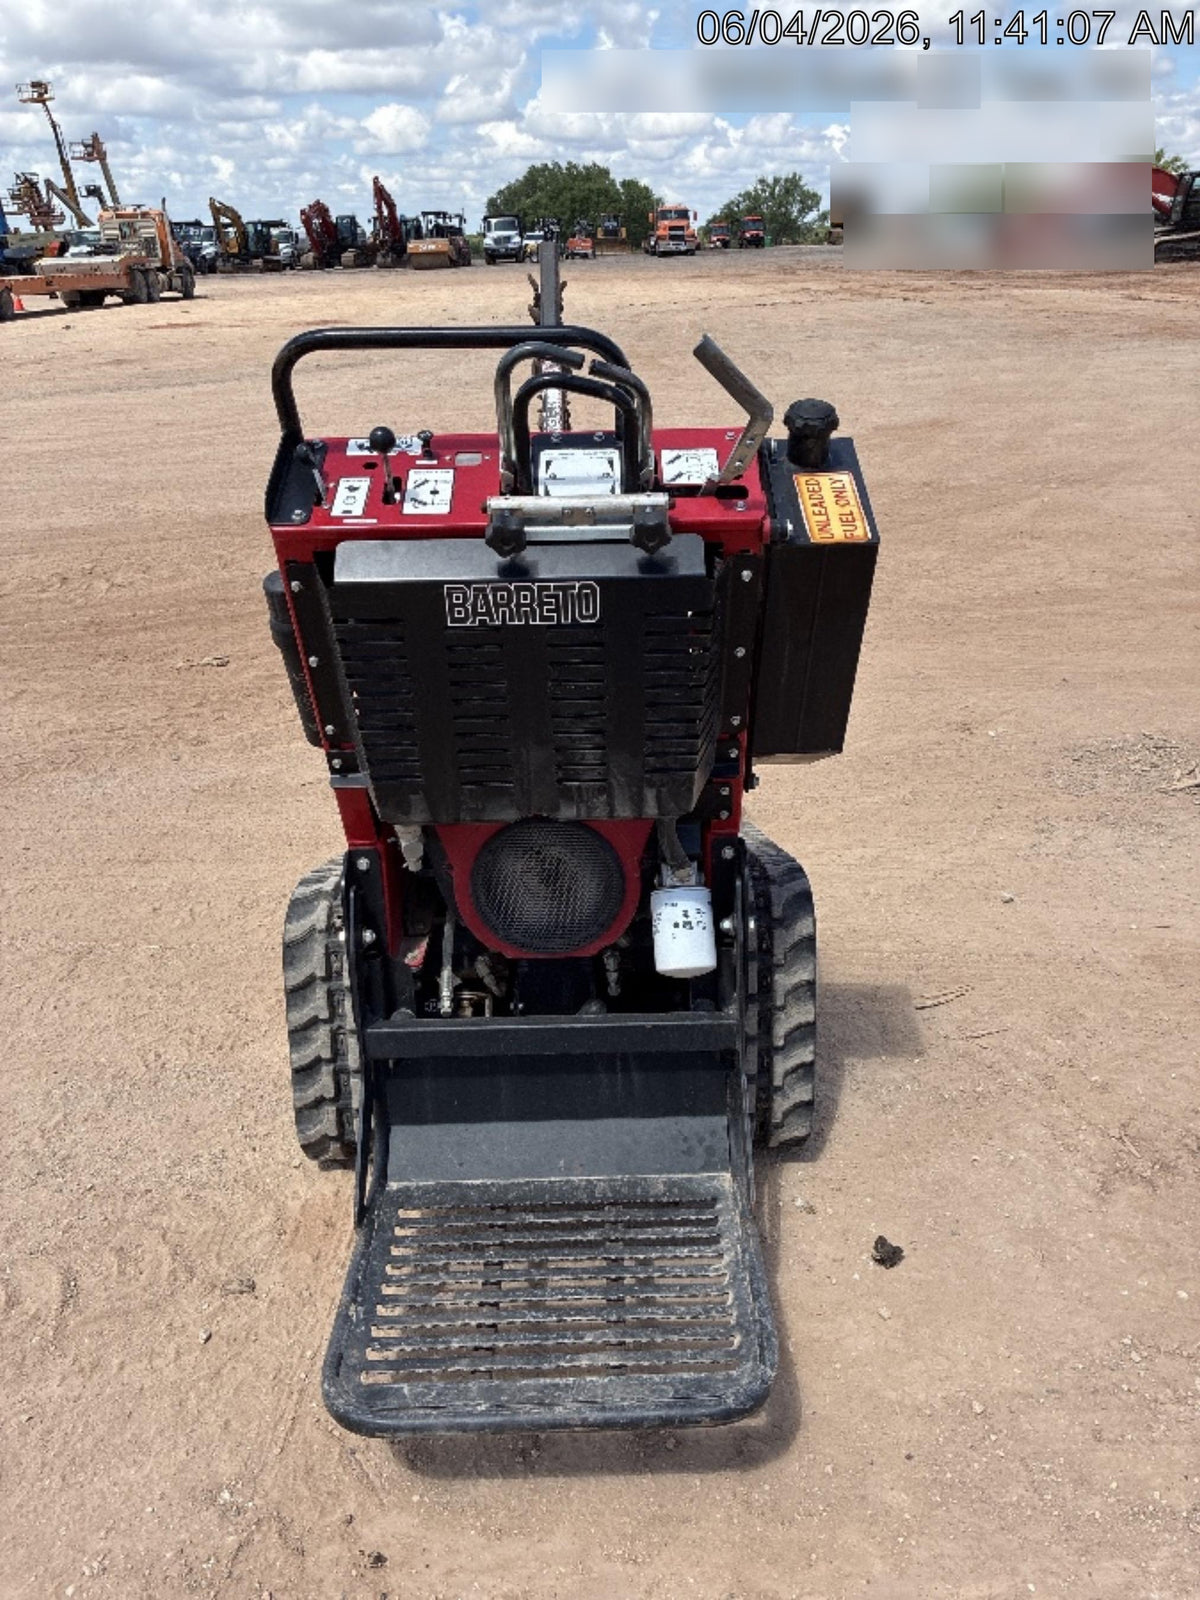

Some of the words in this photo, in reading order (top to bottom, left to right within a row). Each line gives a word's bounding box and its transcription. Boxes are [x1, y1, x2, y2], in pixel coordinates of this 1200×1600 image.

[805, 478, 834, 539] UNLEADED
[828, 477, 851, 507] ONLY
[839, 510, 860, 540] FUEL
[444, 581, 600, 626] BARRETO
